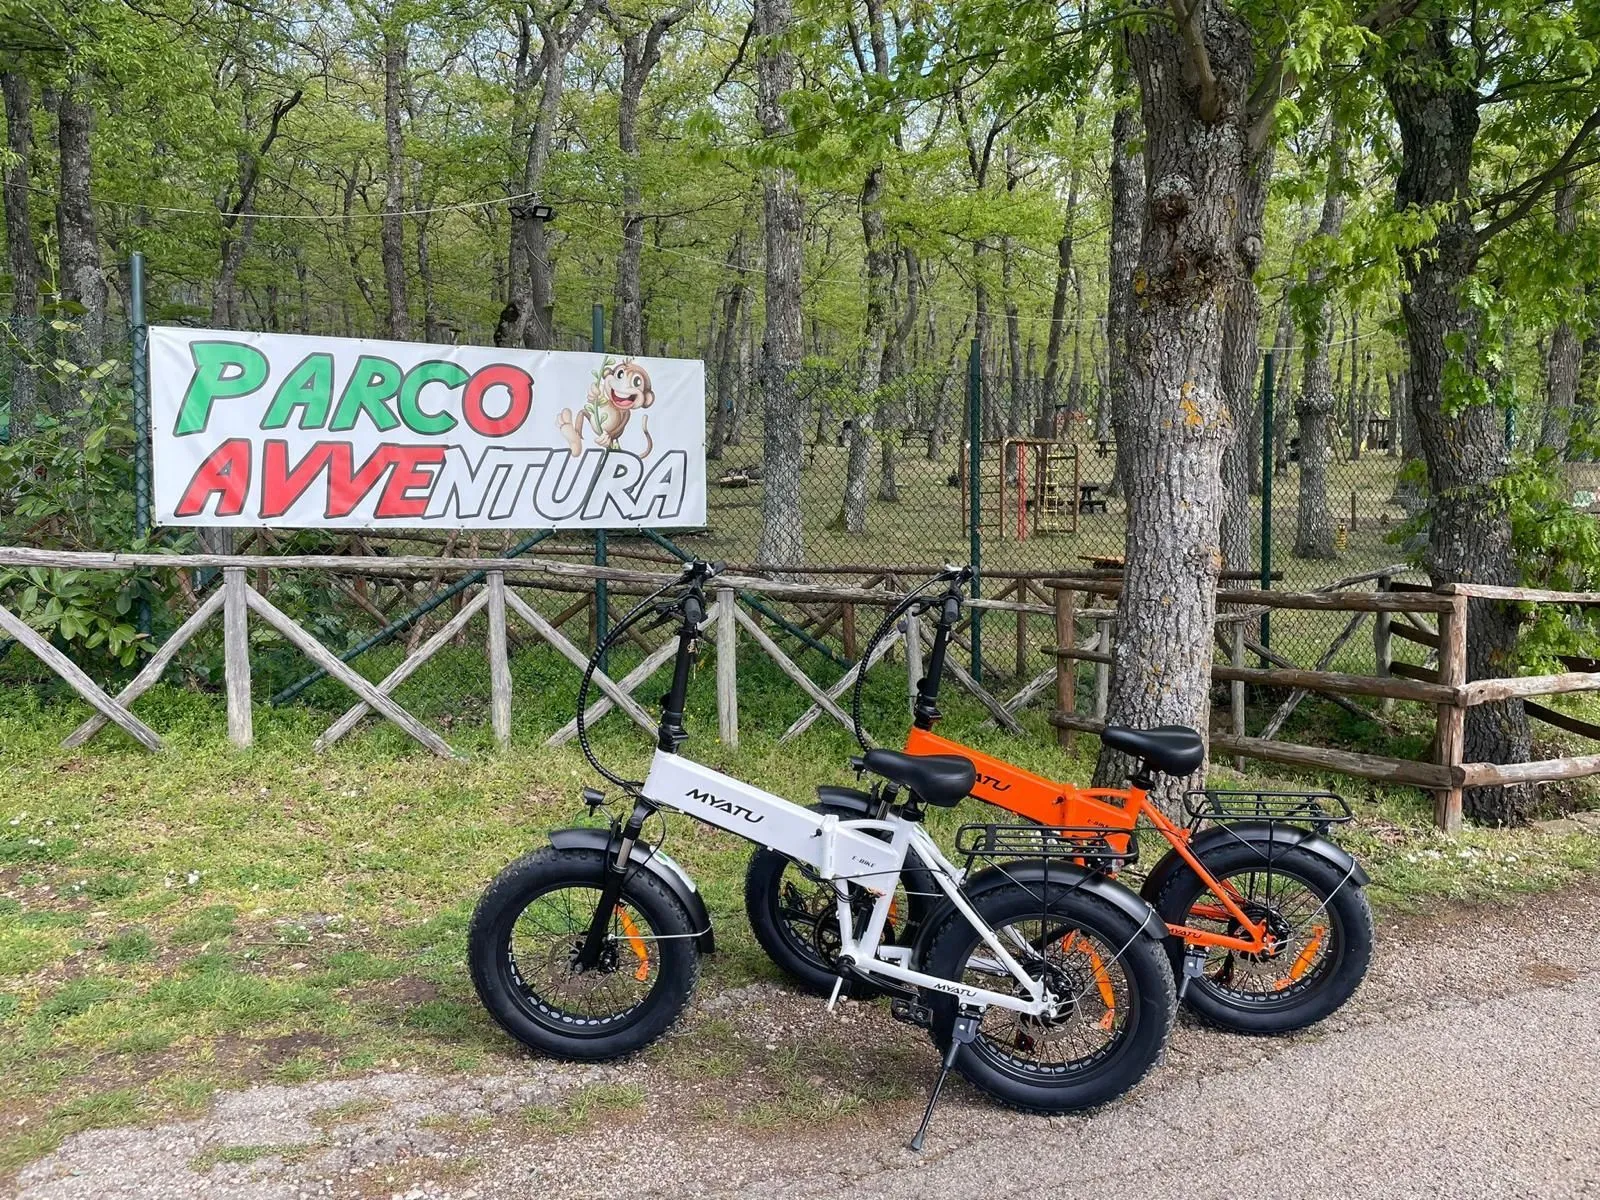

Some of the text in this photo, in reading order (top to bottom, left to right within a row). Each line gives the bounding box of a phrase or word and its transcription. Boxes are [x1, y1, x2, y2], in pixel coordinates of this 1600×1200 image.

[174, 340, 533, 438] PARCO
[175, 438, 688, 521] AVVENTURA
[685, 788, 765, 823] MYATU
[934, 983, 977, 997] MYATU
